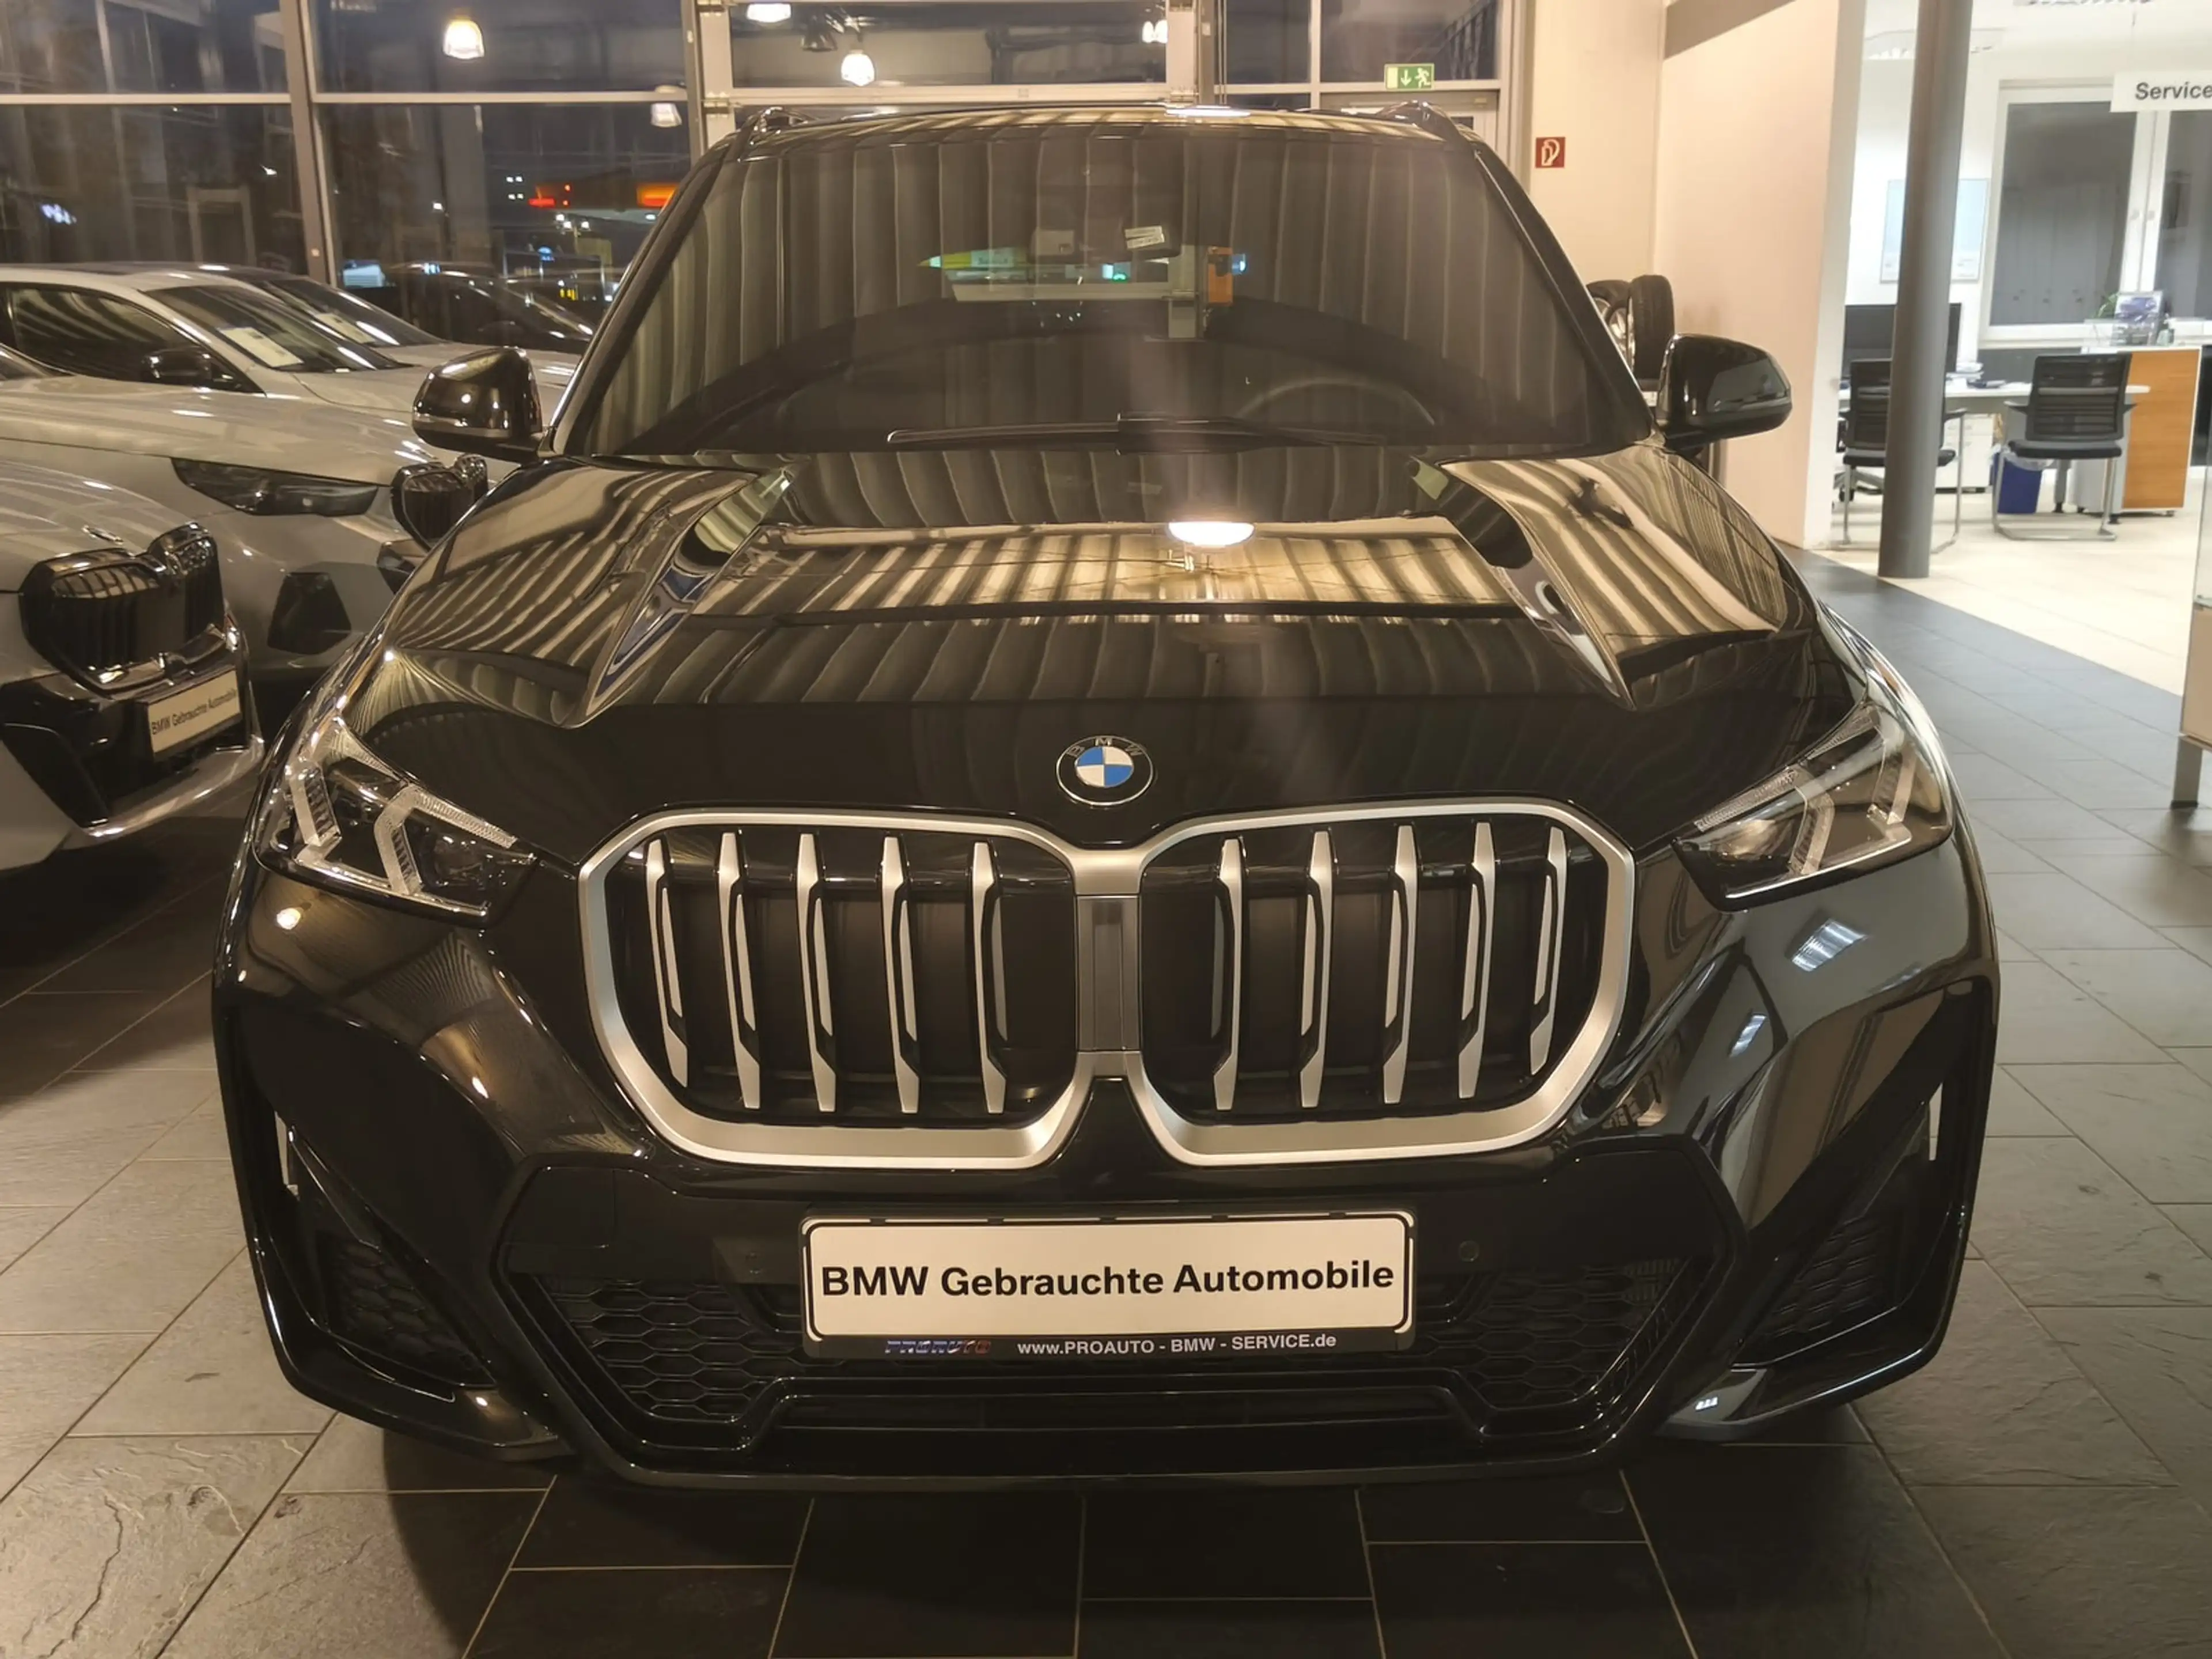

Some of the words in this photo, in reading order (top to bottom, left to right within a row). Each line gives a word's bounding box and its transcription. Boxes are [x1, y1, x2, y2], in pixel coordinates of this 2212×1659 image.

[2135, 81, 2212, 100] Service
[151, 716, 171, 735] BMW
[1066, 737, 1143, 757] BMW
[821, 1266, 929, 1296] BMW
[941, 1266, 1164, 1296] Gebrauchte
[1173, 1259, 1394, 1293] Automobile
[1171, 1338, 1216, 1353] BMW
[1231, 1333, 1337, 1351] SERVICE.de
